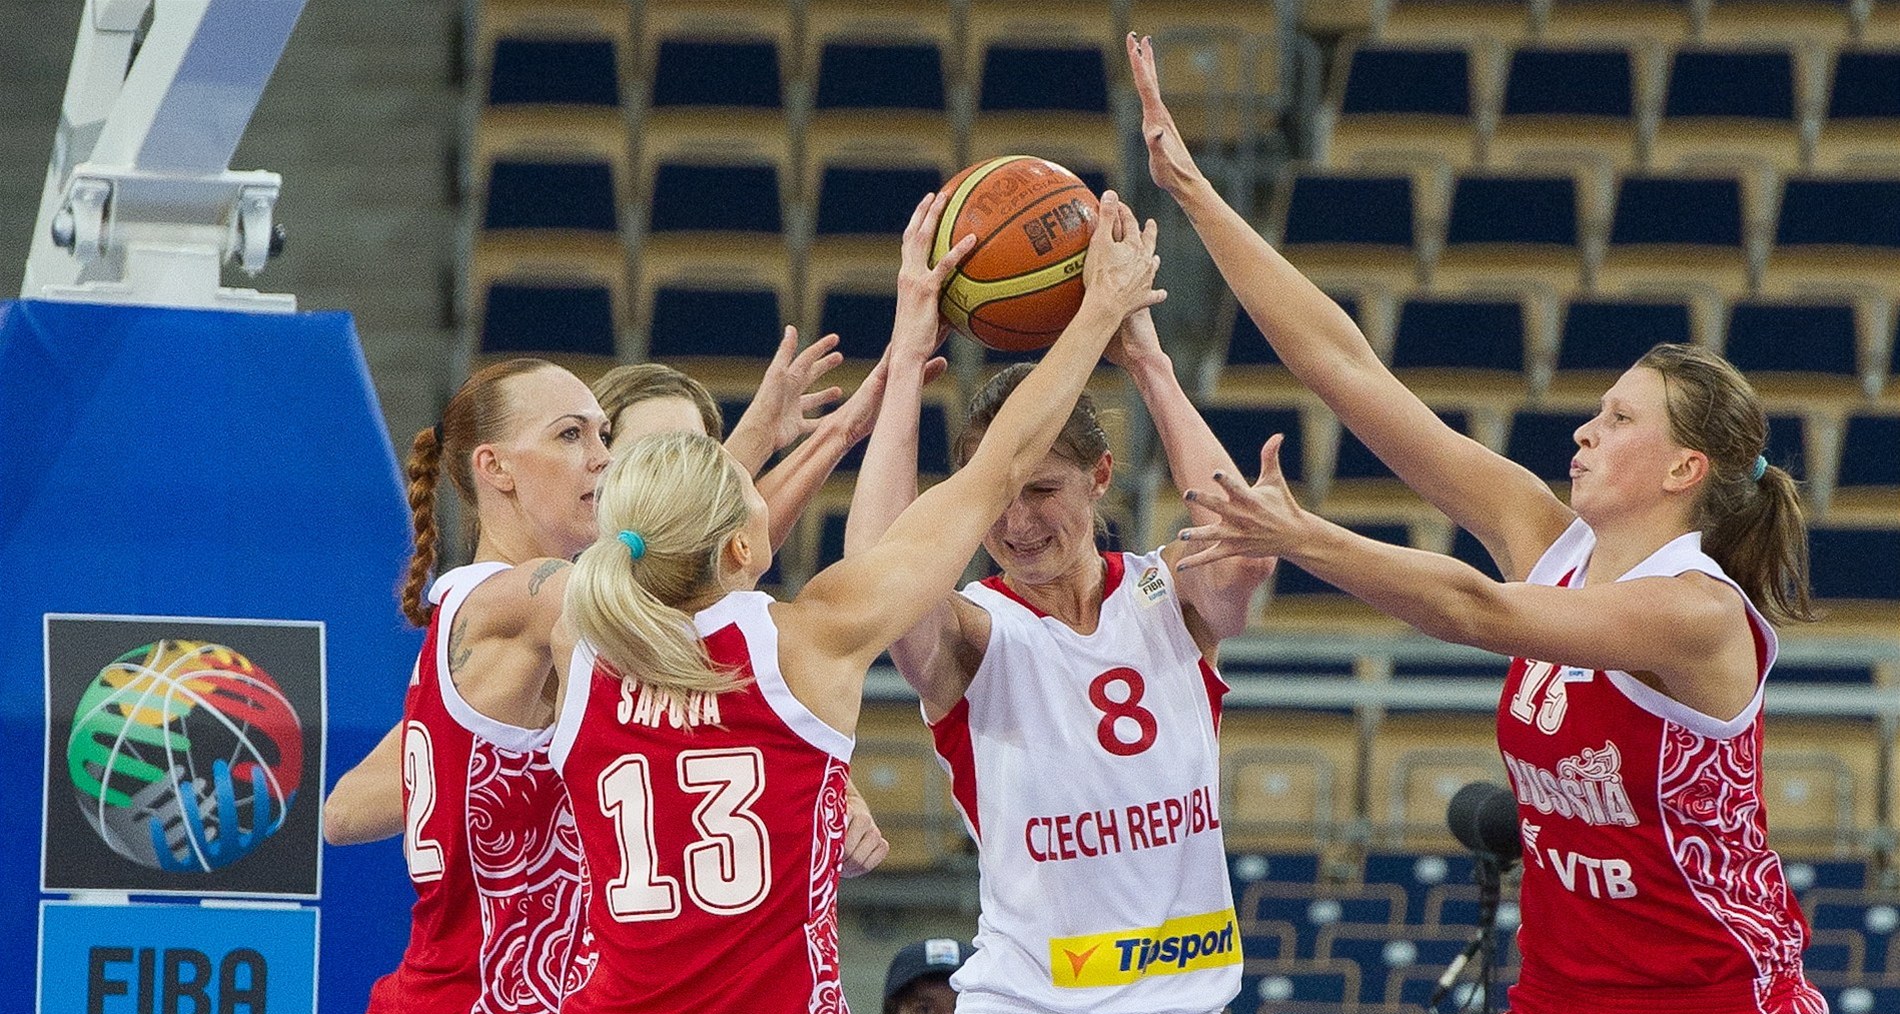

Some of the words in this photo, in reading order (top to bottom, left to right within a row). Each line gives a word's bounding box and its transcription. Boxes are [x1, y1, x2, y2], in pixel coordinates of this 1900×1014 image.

[1063, 258, 1084, 275] GL
[1142, 578, 1165, 595] FIBA
[1088, 666, 1158, 757] 8
[403, 719, 446, 884] 2
[1025, 808, 1121, 862] CZECH
[1126, 785, 1220, 851] REPUBL
[1503, 750, 1640, 827] RUSSIA
[597, 746, 772, 923] 13
[1547, 848, 1638, 899] VTB
